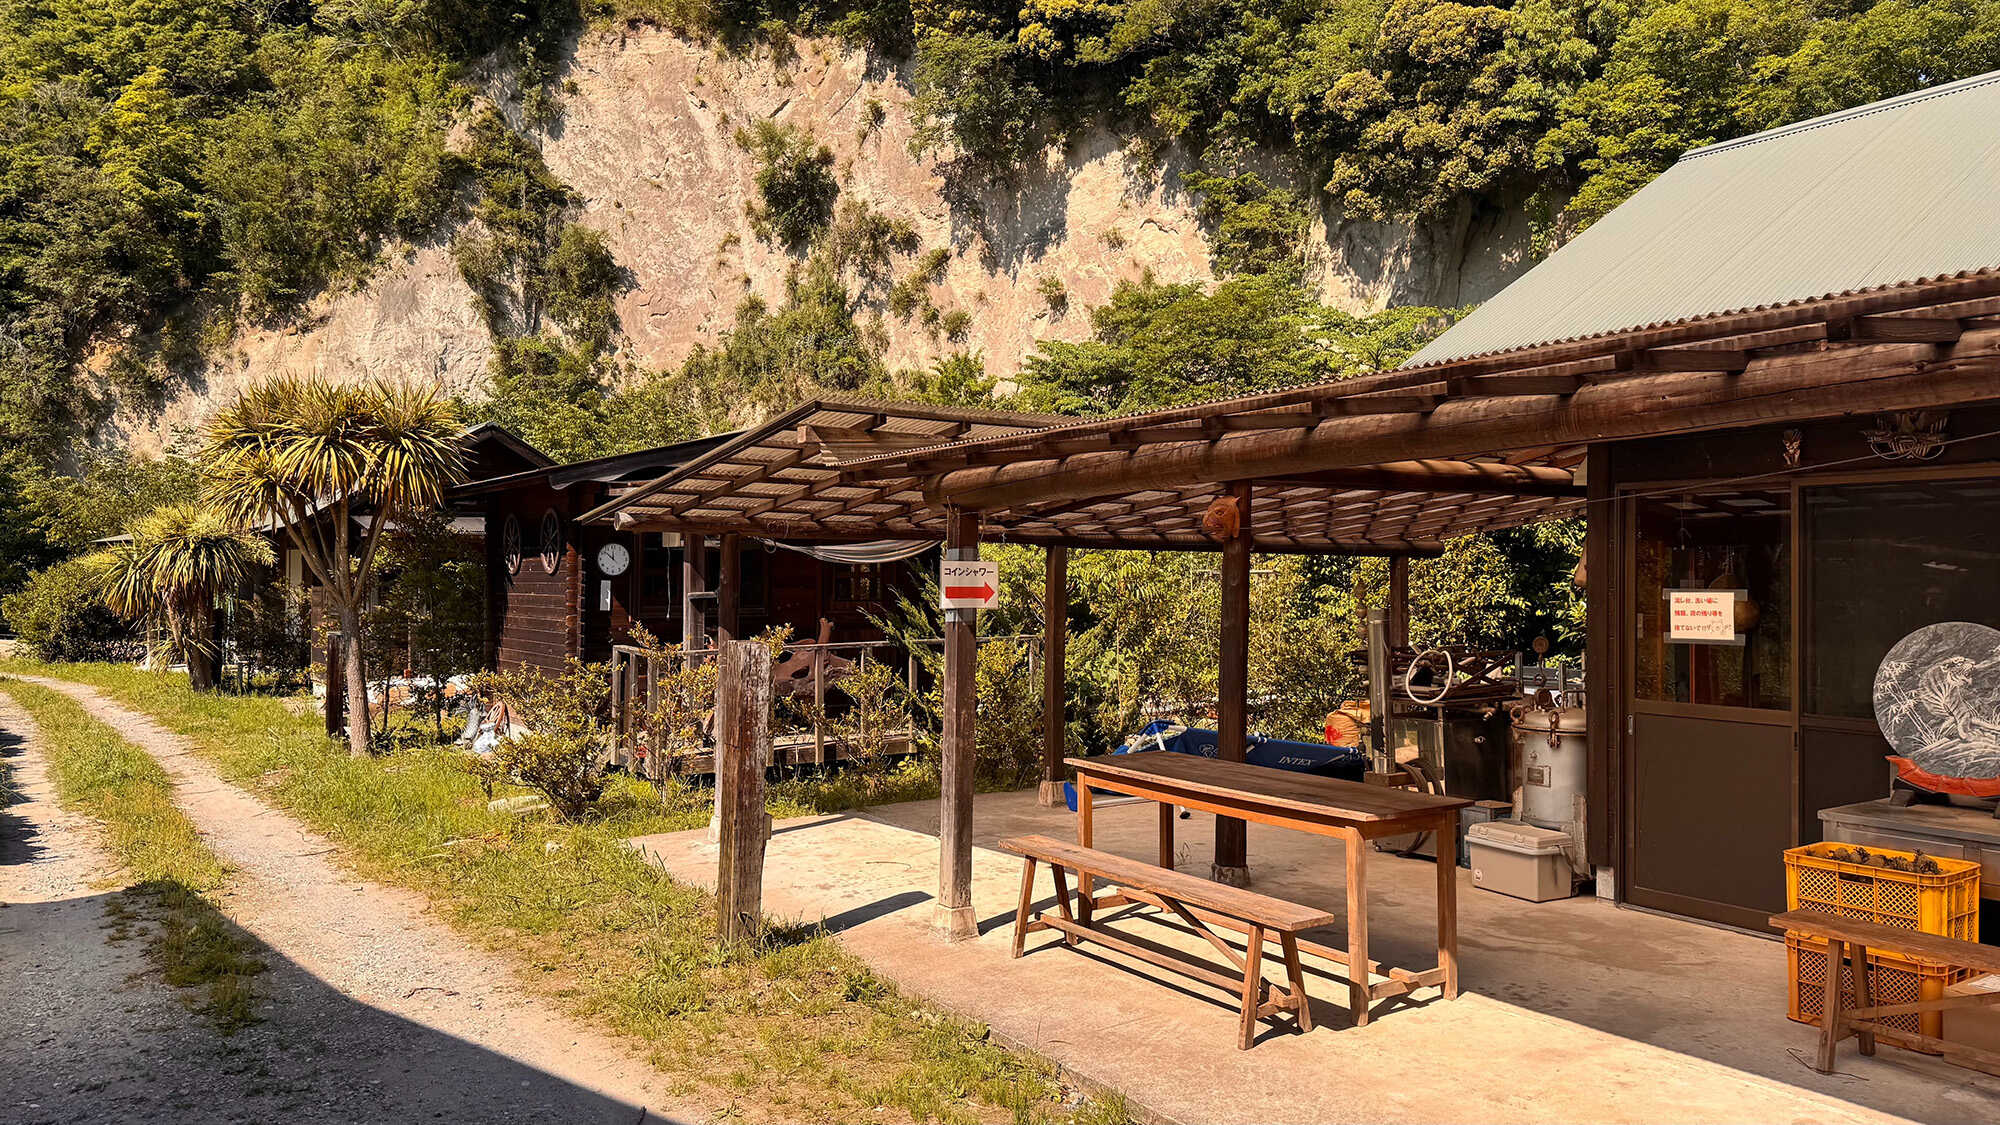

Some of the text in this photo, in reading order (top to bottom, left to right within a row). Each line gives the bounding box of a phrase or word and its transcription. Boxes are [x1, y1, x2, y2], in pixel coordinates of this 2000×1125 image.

[944, 567, 994, 577] コインシャワー
[1278, 756, 1316, 767] INTEX
